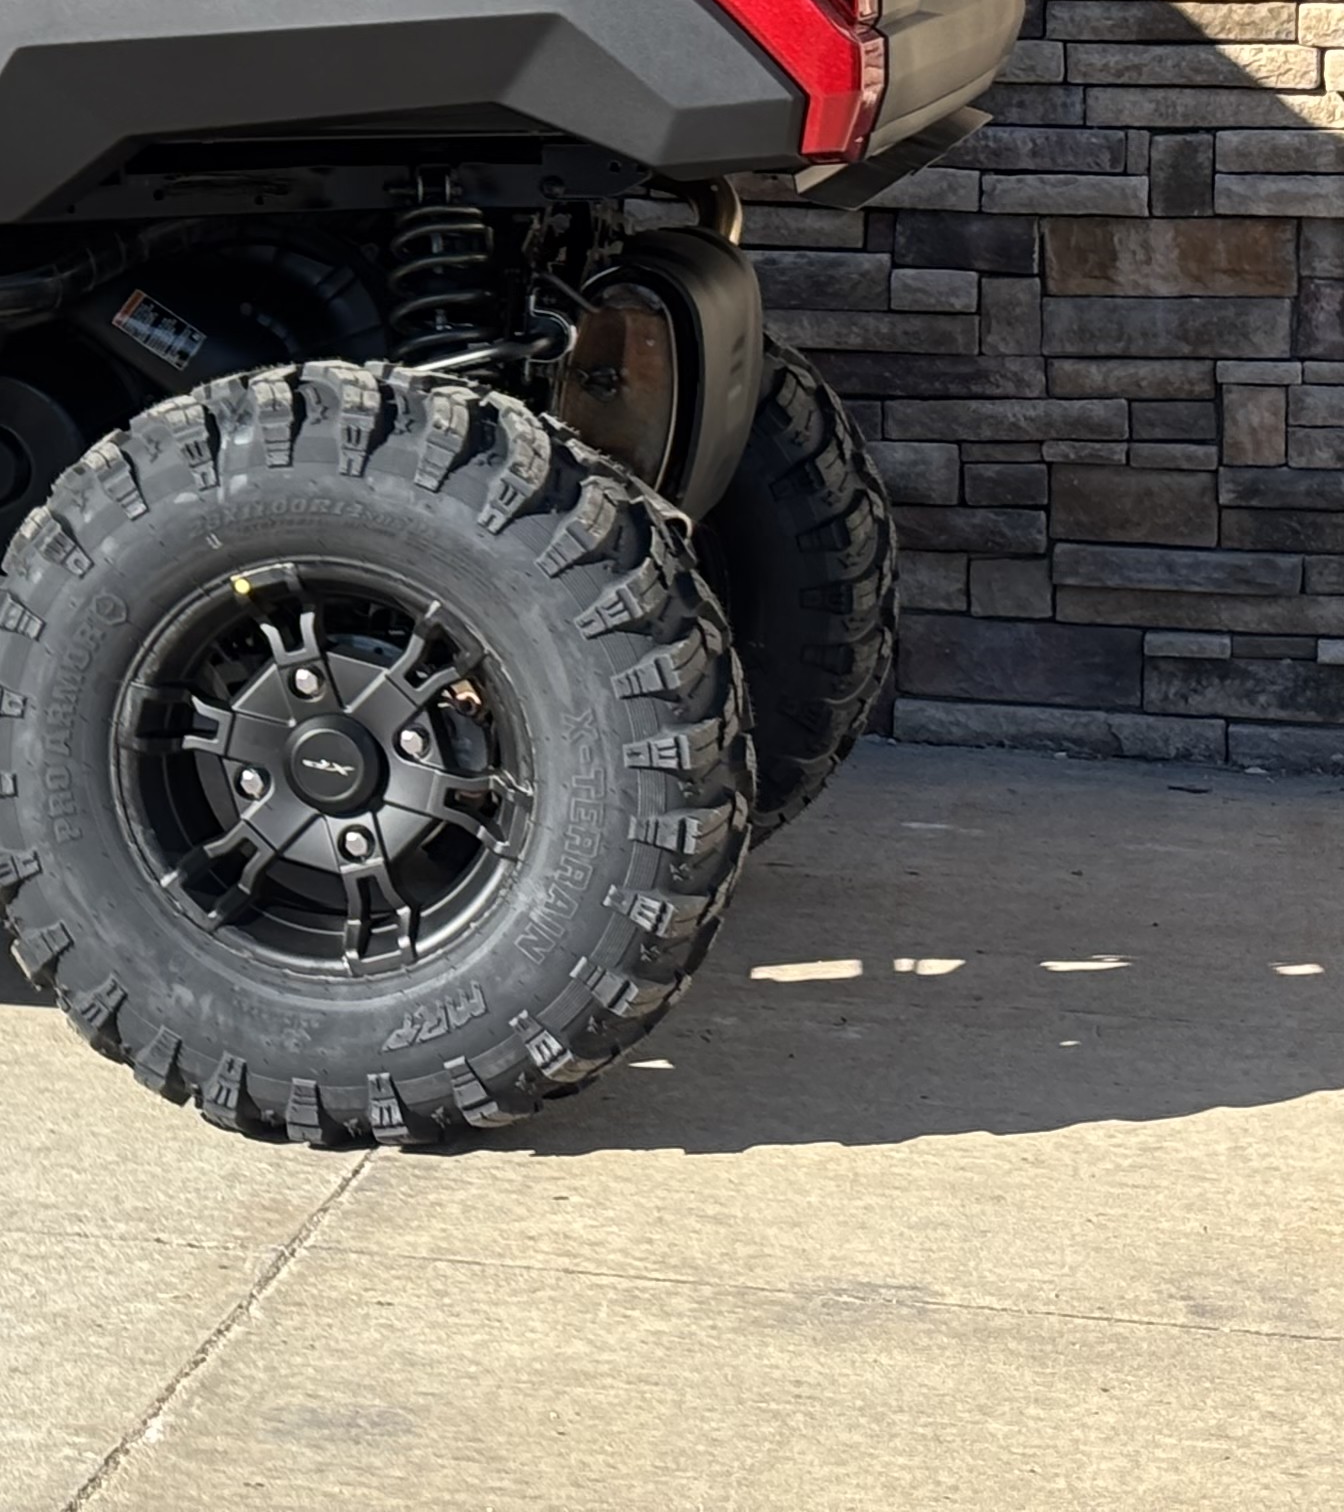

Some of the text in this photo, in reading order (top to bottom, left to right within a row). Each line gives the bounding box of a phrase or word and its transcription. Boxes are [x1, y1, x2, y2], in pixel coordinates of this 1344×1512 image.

[44, 621, 107, 844] PRO ARMOR
[514, 707, 607, 966] X-TERRAIN
